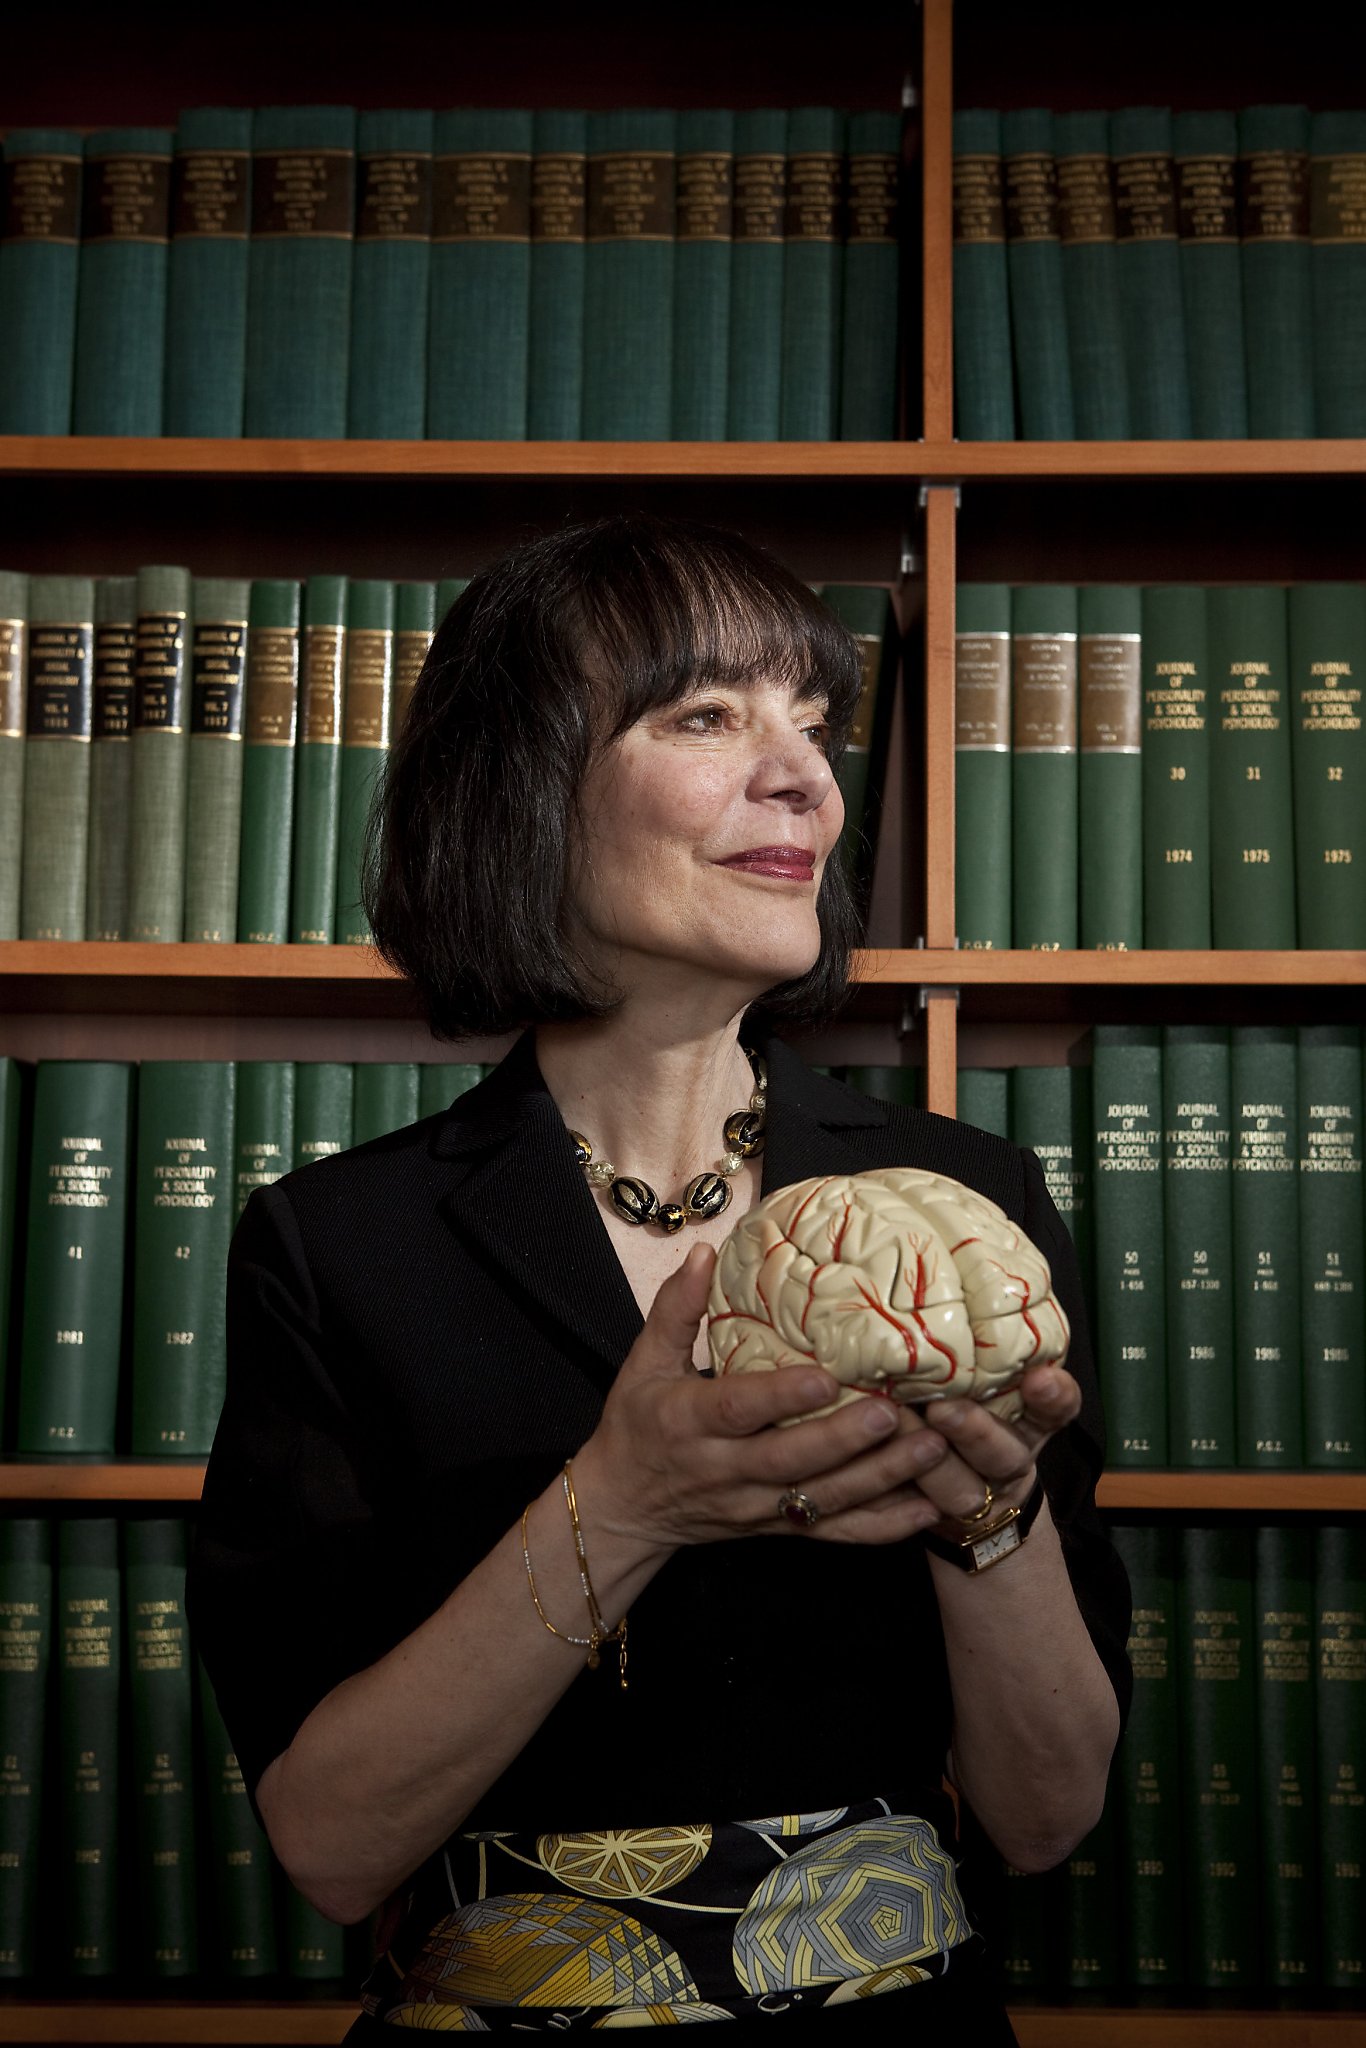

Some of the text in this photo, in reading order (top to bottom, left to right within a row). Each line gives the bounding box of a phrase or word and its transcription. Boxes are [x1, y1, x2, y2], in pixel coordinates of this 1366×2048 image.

[1155, 662, 1197, 675] JOURNAL
[1230, 662, 1271, 675] JOURNAL
[1310, 662, 1352, 675] JOURNAL
[1169, 675, 1183, 688] OF
[1244, 675, 1258, 688] OF
[1325, 675, 1338, 688] OF
[1146, 689, 1206, 702] PERSONALITY
[1220, 689, 1280, 702] PERSONALITY
[1301, 689, 1361, 702] PERSONALITY
[1154, 703, 1198, 716] & SOCIAL
[1229, 703, 1273, 716] & SOCIAL
[1310, 703, 1354, 716] & SOCIAL
[1147, 717, 1205, 730] PSYCHOLOGY
[1222, 717, 1280, 730] PSYCHOLOGY
[1302, 717, 1361, 730] PSYCHOLOGY
[1170, 766, 1186, 781] 30
[1246, 766, 1261, 781] 31
[1327, 766, 1343, 781] 32
[1165, 849, 1193, 863] 1974
[1243, 849, 1270, 863] 1975
[1324, 849, 1352, 863] 1975
[1108, 1104, 1149, 1117] JOURNAL
[1177, 1103, 1219, 1116] JOURNAL
[1242, 1104, 1285, 1117] JOURNAL
[1310, 1105, 1352, 1118] JOURNAL
[1122, 1118, 1135, 1130] OF
[1192, 1117, 1204, 1129] OF
[1257, 1118, 1269, 1130] OF
[1325, 1119, 1337, 1131] OF
[1097, 1131, 1160, 1144] PERSONALITY
[1166, 1130, 1229, 1143] PERSONALITY
[1240, 1131, 1286, 1144] PERSONALITY
[1308, 1132, 1354, 1145] PERSONALITY
[62, 1138, 103, 1151] JOURNAL
[165, 1138, 207, 1151] JOURNAL
[1107, 1145, 1150, 1157] & SOCIAL
[1176, 1144, 1219, 1156] & SOCIAL
[1241, 1145, 1285, 1157] & SOCIAL
[74, 1152, 88, 1164] OF
[178, 1152, 192, 1164] OF
[1310, 1146, 1353, 1158] & SOCIAL
[253, 1158, 266, 1170] OF
[1046, 1159, 1060, 1171] OF
[1099, 1158, 1160, 1171] PSYCHOLOGY
[1168, 1158, 1229, 1170] PSYCHOLOGY
[1232, 1158, 1294, 1171] PSYCHOLOGY
[1301, 1159, 1362, 1172] PSYCHOLOGY
[50, 1165, 113, 1179] PERSONALITY
[154, 1166, 217, 1179] PERSONALITY
[1044, 1172, 1084, 1184] ONALITY
[56, 1180, 101, 1193] & SOCIAL
[162, 1180, 207, 1193] & SOCIAL
[49, 1193, 110, 1207] PSYCHOLOGY
[154, 1194, 215, 1207] PSYCHOLOGY
[68, 1246, 82, 1259] 41
[175, 1246, 190, 1259] 42
[1125, 1251, 1138, 1264] 50
[1194, 1251, 1207, 1263] 50
[1258, 1252, 1271, 1264] 51
[1327, 1253, 1339, 1265] 51
